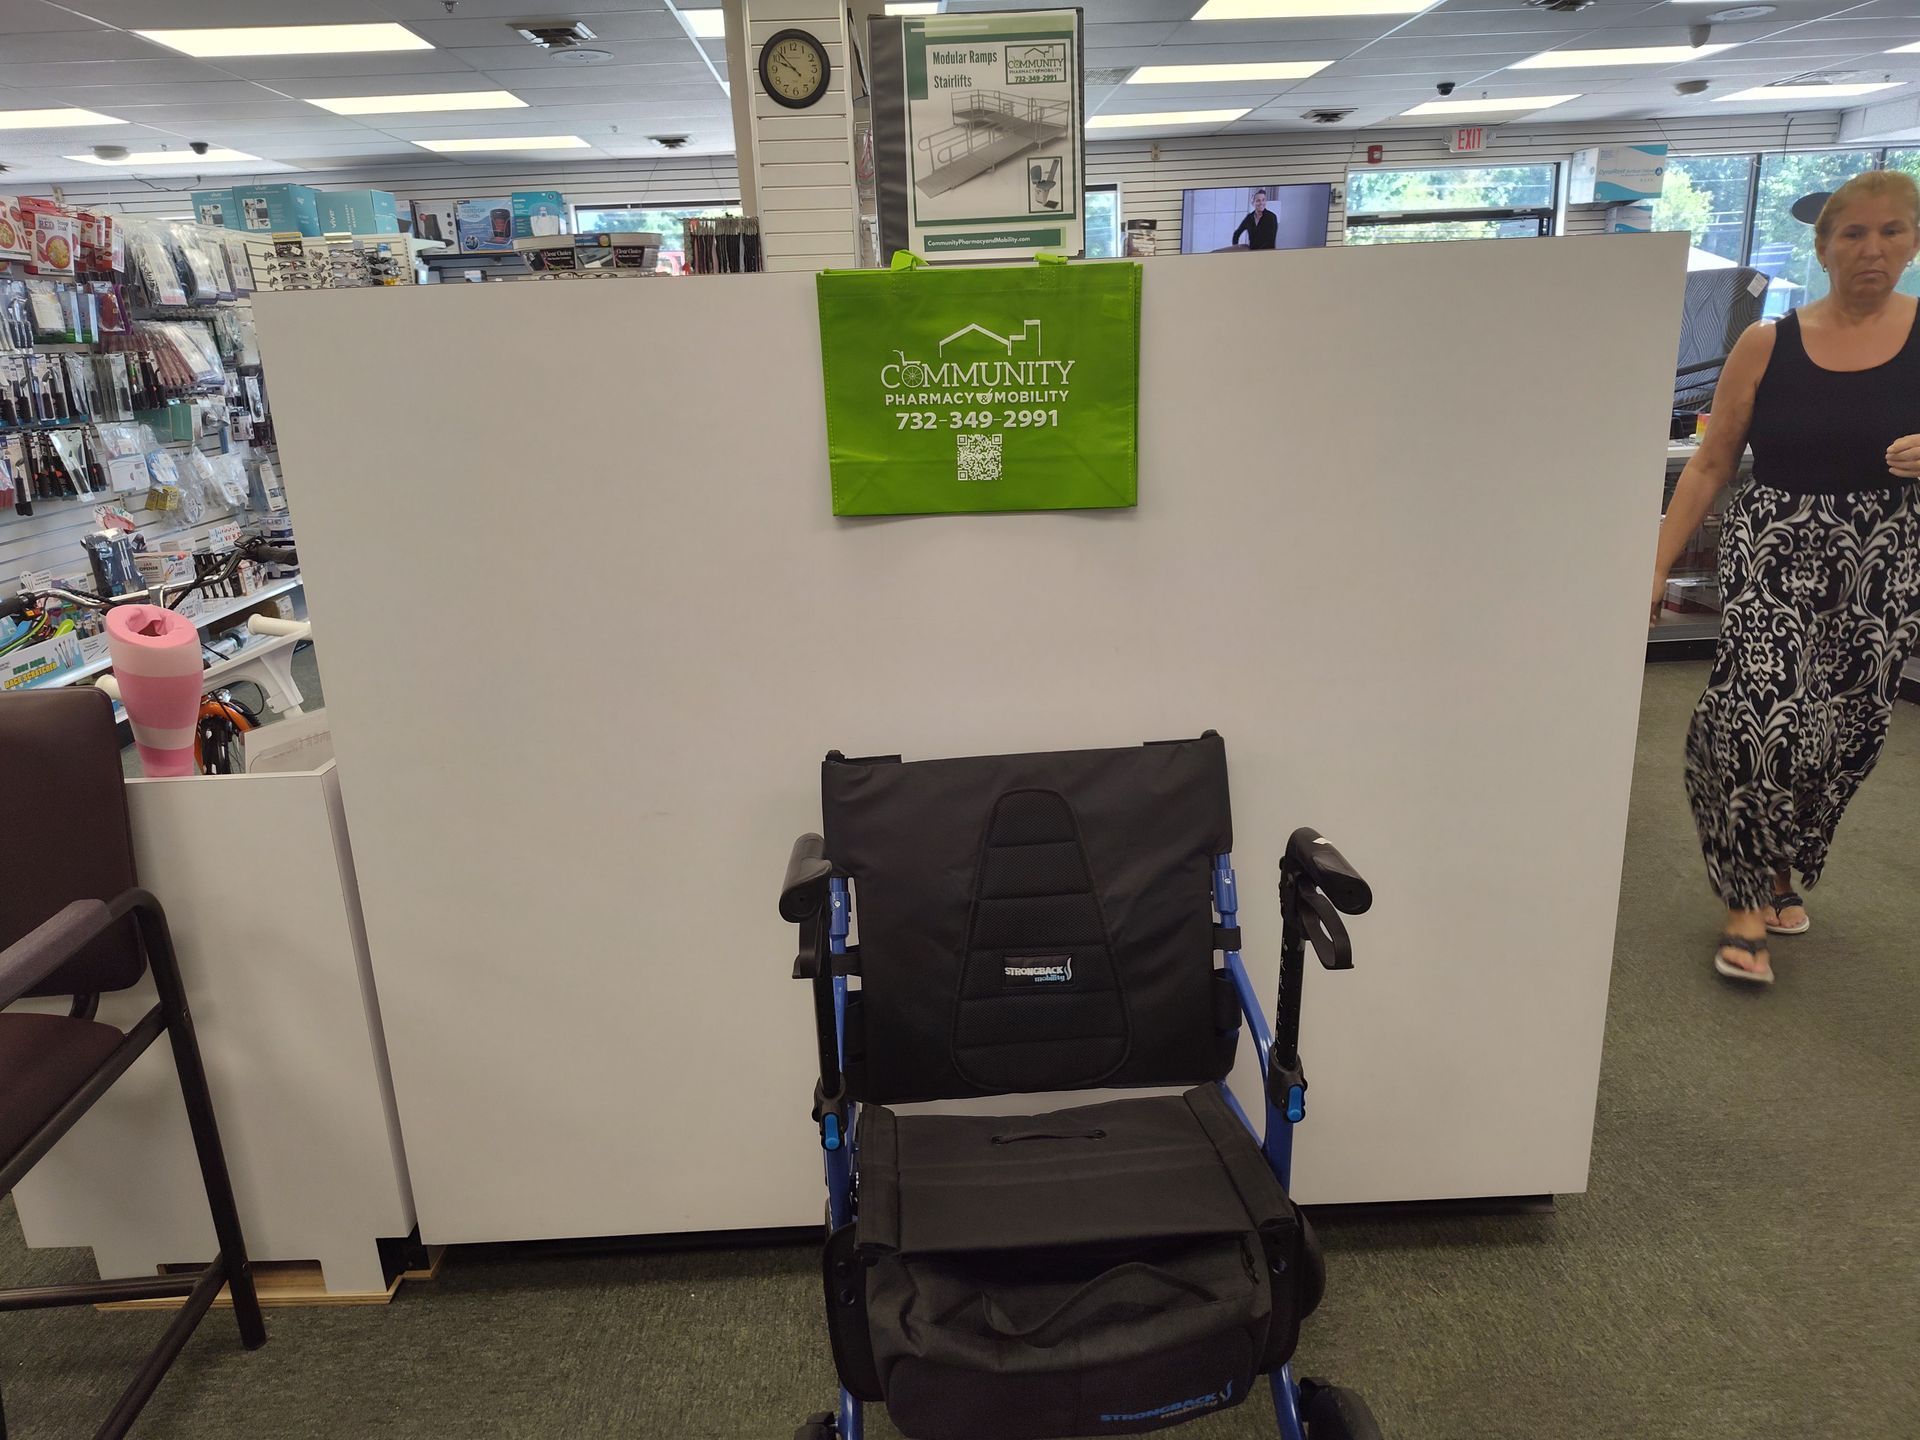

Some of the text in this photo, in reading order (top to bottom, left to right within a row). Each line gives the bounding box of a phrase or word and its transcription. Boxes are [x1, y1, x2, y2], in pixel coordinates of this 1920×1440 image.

[789, 42, 797, 51] 12
[801, 45, 805, 54] 1
[808, 53, 815, 62] 2
[933, 50, 998, 66] Modular Ramps
[1008, 58, 1064, 69] COMMUNITY
[772, 65, 778, 73] 9
[775, 76, 781, 85] 8
[934, 74, 972, 89] Stairlifts
[1015, 74, 1057, 83] 732-349-2991
[783, 84, 789, 93] 7
[793, 87, 799, 96] 6
[803, 84, 809, 92] 5
[1456, 128, 1483, 150] EXIT
[927, 237, 1031, 247] CommunityPharmacyandMobility.com
[881, 360, 1075, 388] COMMUNITY
[885, 391, 975, 406] PHARMACY
[994, 390, 1069, 403] MOBILITY
[896, 409, 1058, 430] 732-349-2991
[1004, 966, 1064, 976] STRONGBACK
